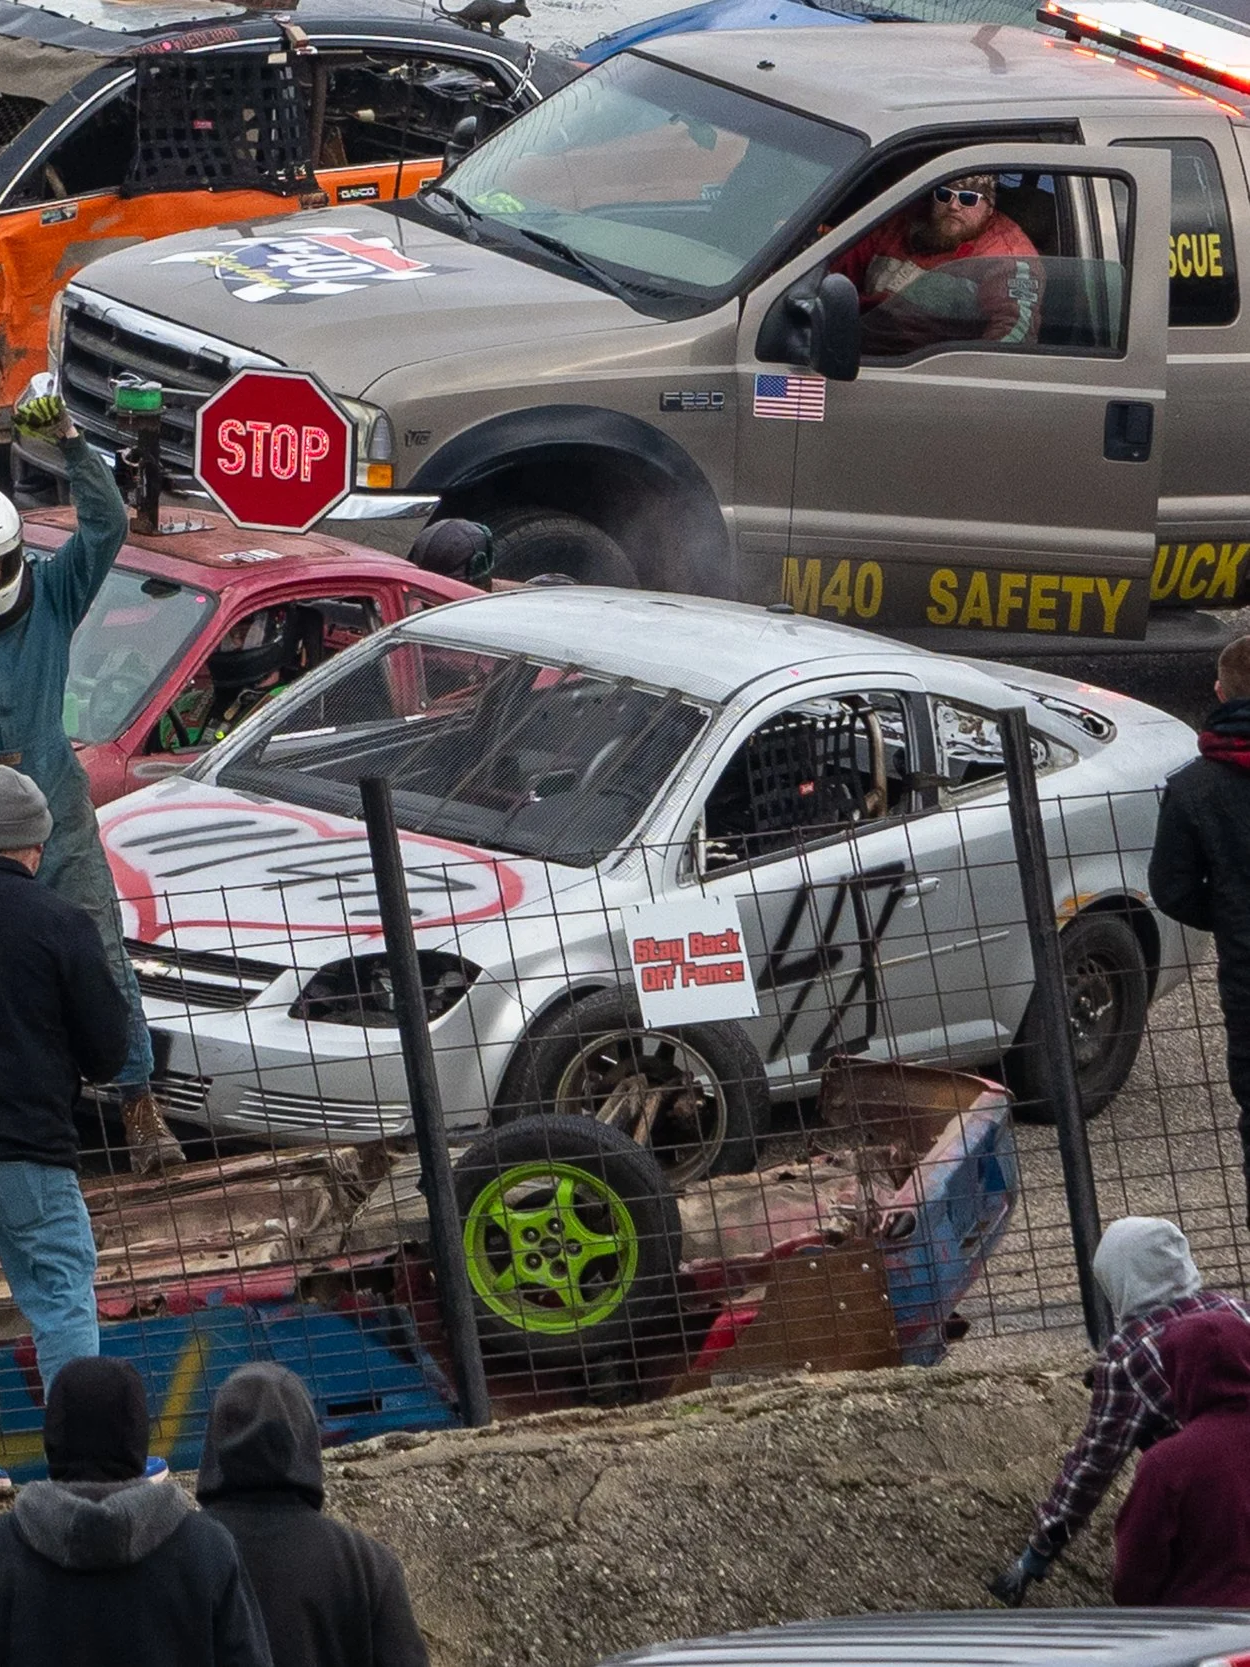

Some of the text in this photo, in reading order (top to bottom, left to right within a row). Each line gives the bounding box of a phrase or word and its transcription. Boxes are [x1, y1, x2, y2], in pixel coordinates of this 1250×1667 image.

[1168, 233, 1224, 278] SCUE
[662, 391, 725, 406] F250
[217, 419, 330, 482] STOP
[782, 543, 1250, 634] M40 SAFETY UCK
[633, 928, 743, 965] Stay Back
[641, 960, 746, 993] Off Fence
